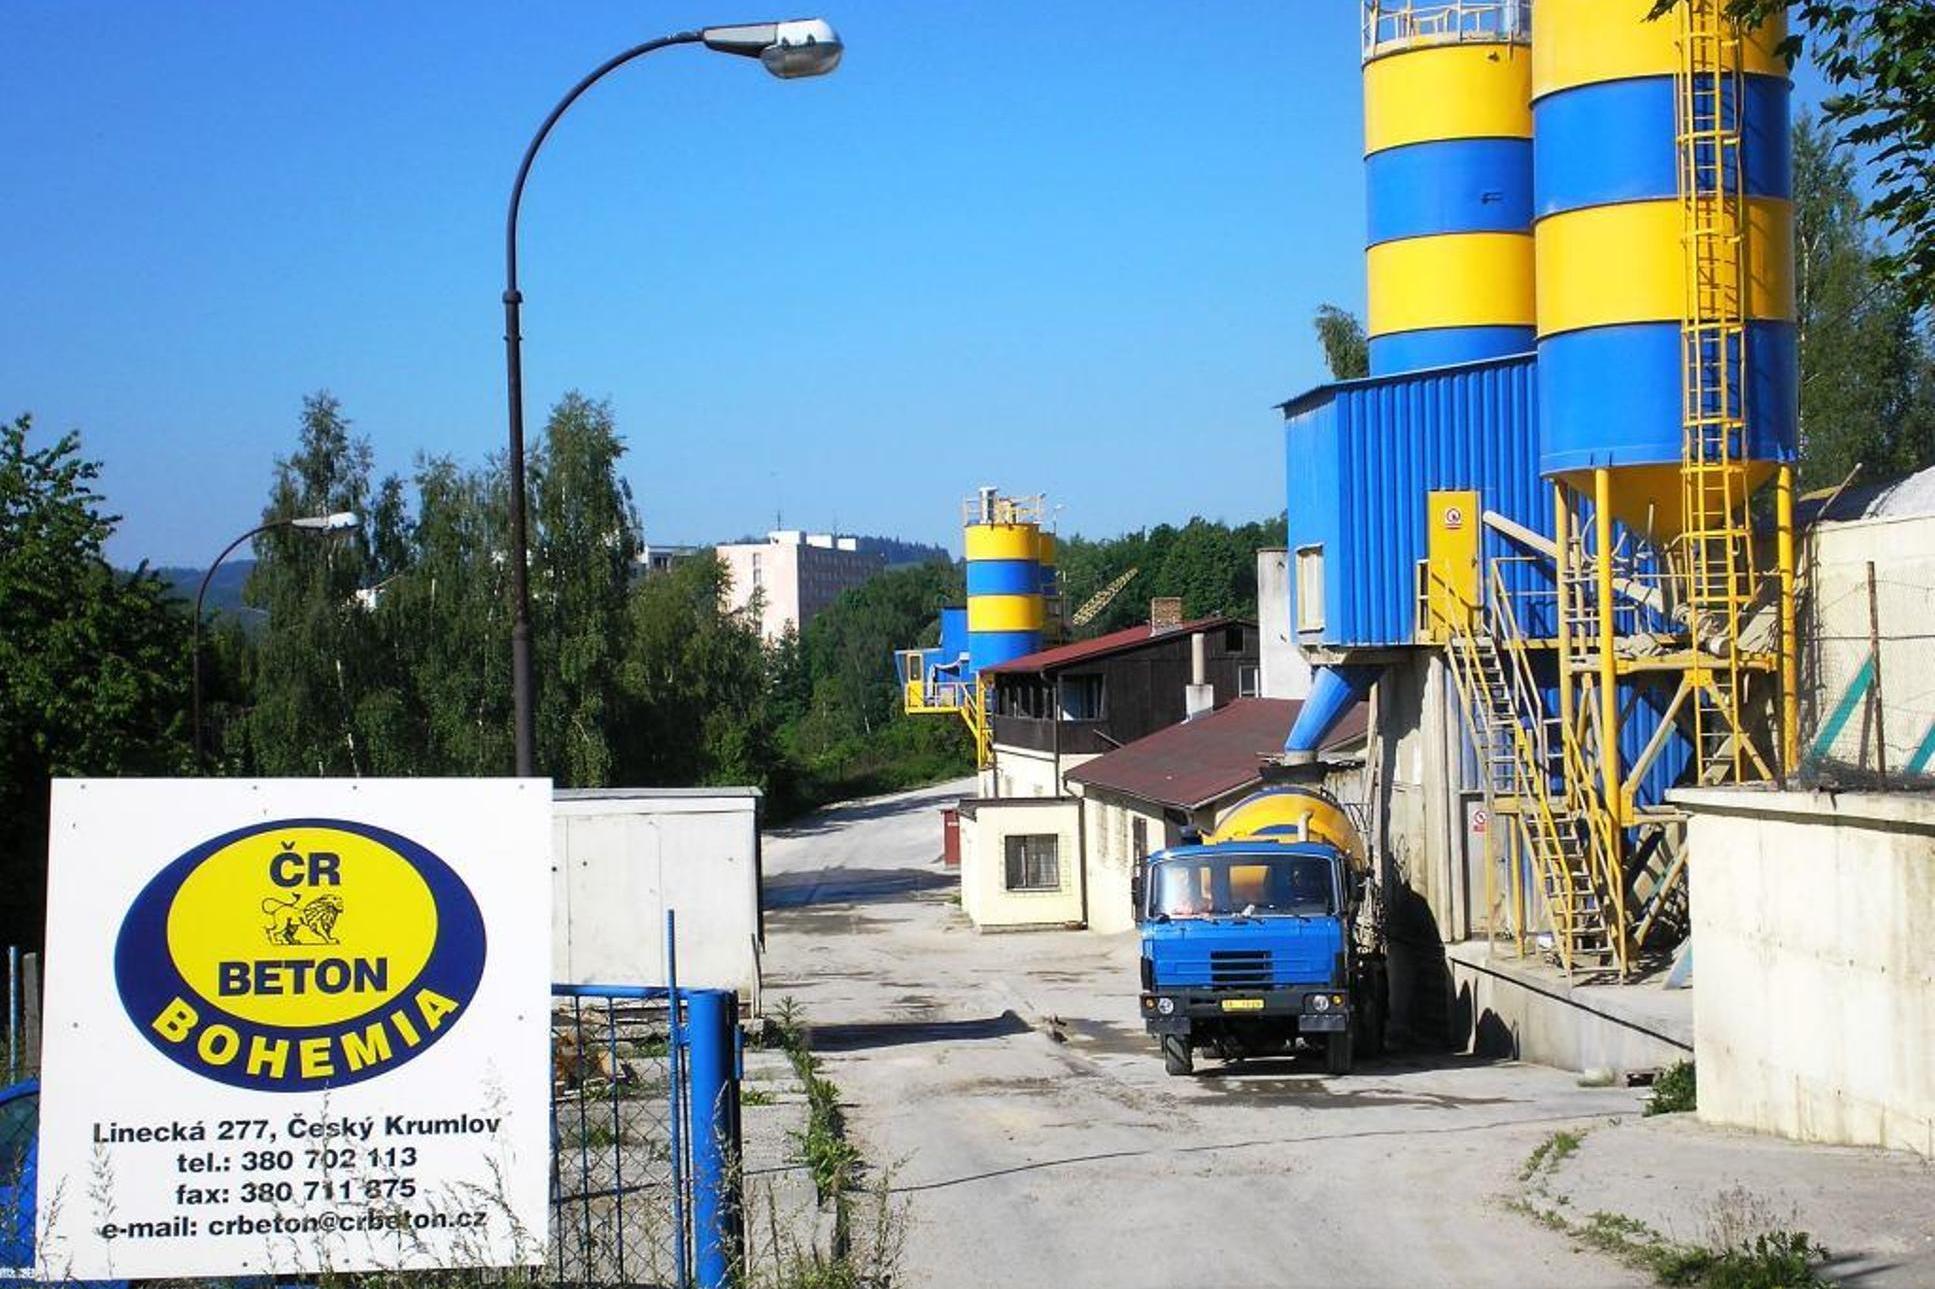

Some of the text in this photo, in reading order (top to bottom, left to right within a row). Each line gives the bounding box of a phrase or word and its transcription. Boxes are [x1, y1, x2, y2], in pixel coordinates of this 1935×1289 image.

[269, 840, 341, 888] ČR
[218, 956, 388, 997] BETON
[151, 987, 459, 1080] BOHEMIA
[93, 1112, 500, 1143] Linecká 277, Český Krumlov
[176, 1147, 417, 1173] tel.: 380 702 113
[175, 1184, 229, 1205] fax:
[239, 1182, 293, 1203] 380
[303, 1180, 351, 1200] 711
[101, 1216, 198, 1239] e-mail:
